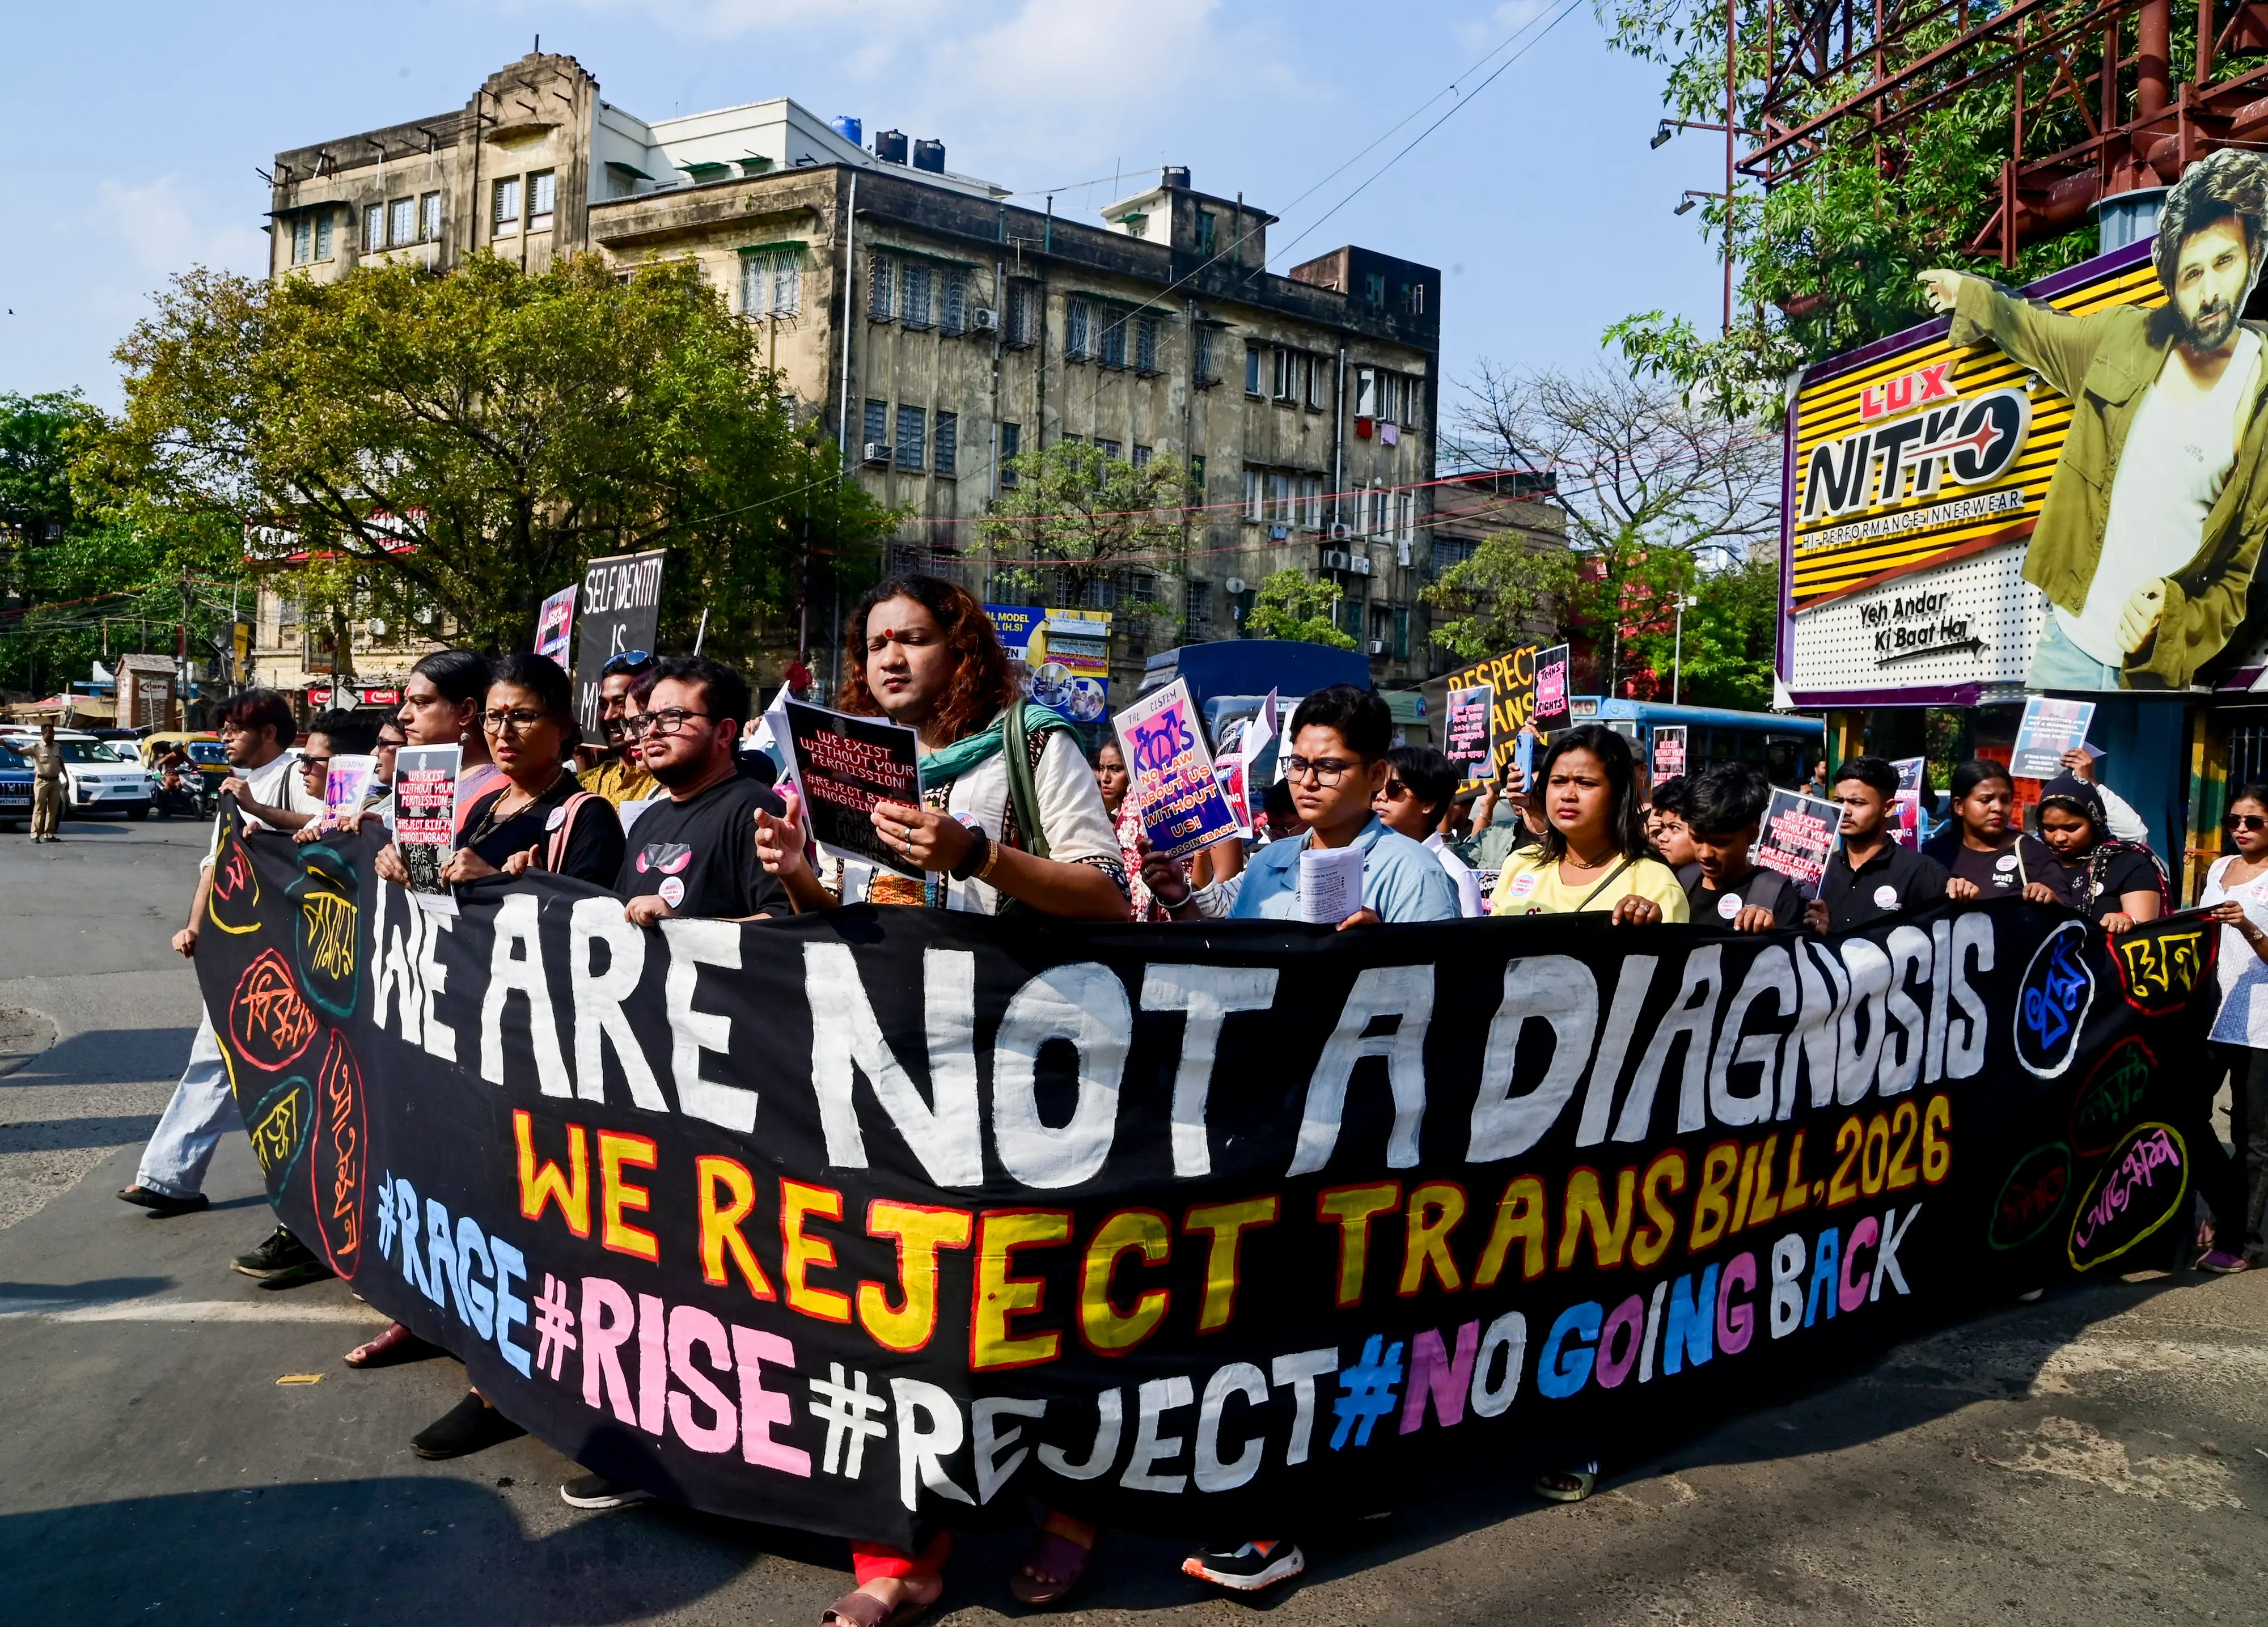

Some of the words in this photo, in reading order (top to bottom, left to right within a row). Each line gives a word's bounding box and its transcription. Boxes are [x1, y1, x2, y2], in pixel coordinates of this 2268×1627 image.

[1860, 361, 1955, 421] LUX
[1802, 513, 1918, 549] HI-PERFORMANCE
[1926, 491, 2020, 525] INNERWEAR
[583, 566, 617, 615] SELF
[615, 557, 664, 611] IDENTITY
[998, 613, 1030, 623] MODEL
[1860, 604, 1888, 626] Yeh
[1894, 591, 1948, 619] Andar
[611, 624, 627, 657] IS
[1002, 623, 1023, 632] (H.S)
[1874, 629, 1891, 651] Ki
[1895, 623, 1936, 647] Baat
[1940, 616, 1969, 639] Hai
[1541, 663, 1560, 680] TRANS
[1128, 711, 1140, 724] THE
[1150, 688, 1177, 712] CISTEM
[1537, 698, 1563, 714] RIGHTS
[799, 737, 870, 768] WITHOUT
[875, 759, 915, 777] YOUR
[816, 730, 840, 748] WE
[845, 738, 891, 760] EXIST
[409, 770, 421, 782] WE
[421, 770, 446, 782] EXIST
[811, 753, 905, 790] PERMISSION!
[1141, 769, 1159, 787] NO
[1162, 750, 1193, 776] LAW
[398, 783, 433, 795] WITHOUT
[434, 782, 454, 794] YOUR
[806, 773, 862, 797] #REJECT
[812, 786, 876, 814] #NOGOIN
[1140, 778, 1183, 808] ABOUT
[1187, 765, 1212, 783] US
[401, 795, 448, 807] PERMISSION!
[1143, 783, 1217, 828] WITHOUT
[1170, 816, 1203, 838] US!
[1770, 816, 1810, 837] WITHOUT
[1810, 829, 1833, 844] YOUR
[1784, 809, 1796, 821] WE
[1798, 814, 1826, 830] EXIST
[1771, 828, 1825, 852] PERMISSION!
[1759, 857, 1819, 884] #NOGOINGBACK
[372, 876, 458, 1063] WE
[480, 893, 760, 1135] ARE
[803, 941, 1280, 1189] NOT
[1285, 960, 1436, 1177] A
[1464, 911, 1995, 1163] DIAGNOSIS
[513, 1108, 660, 1268] WE
[694, 1154, 1281, 1373] REJECT
[1317, 1145, 1688, 1310] TRANS
[378, 1168, 532, 1380] #RAGE
[534, 1272, 812, 1478] #RISE
[809, 1346, 1340, 1512] #REJECT
[1330, 1310, 1526, 1452] #NO
[1535, 1251, 1757, 1400] GOING
[1768, 1201, 1923, 1340] BACK
